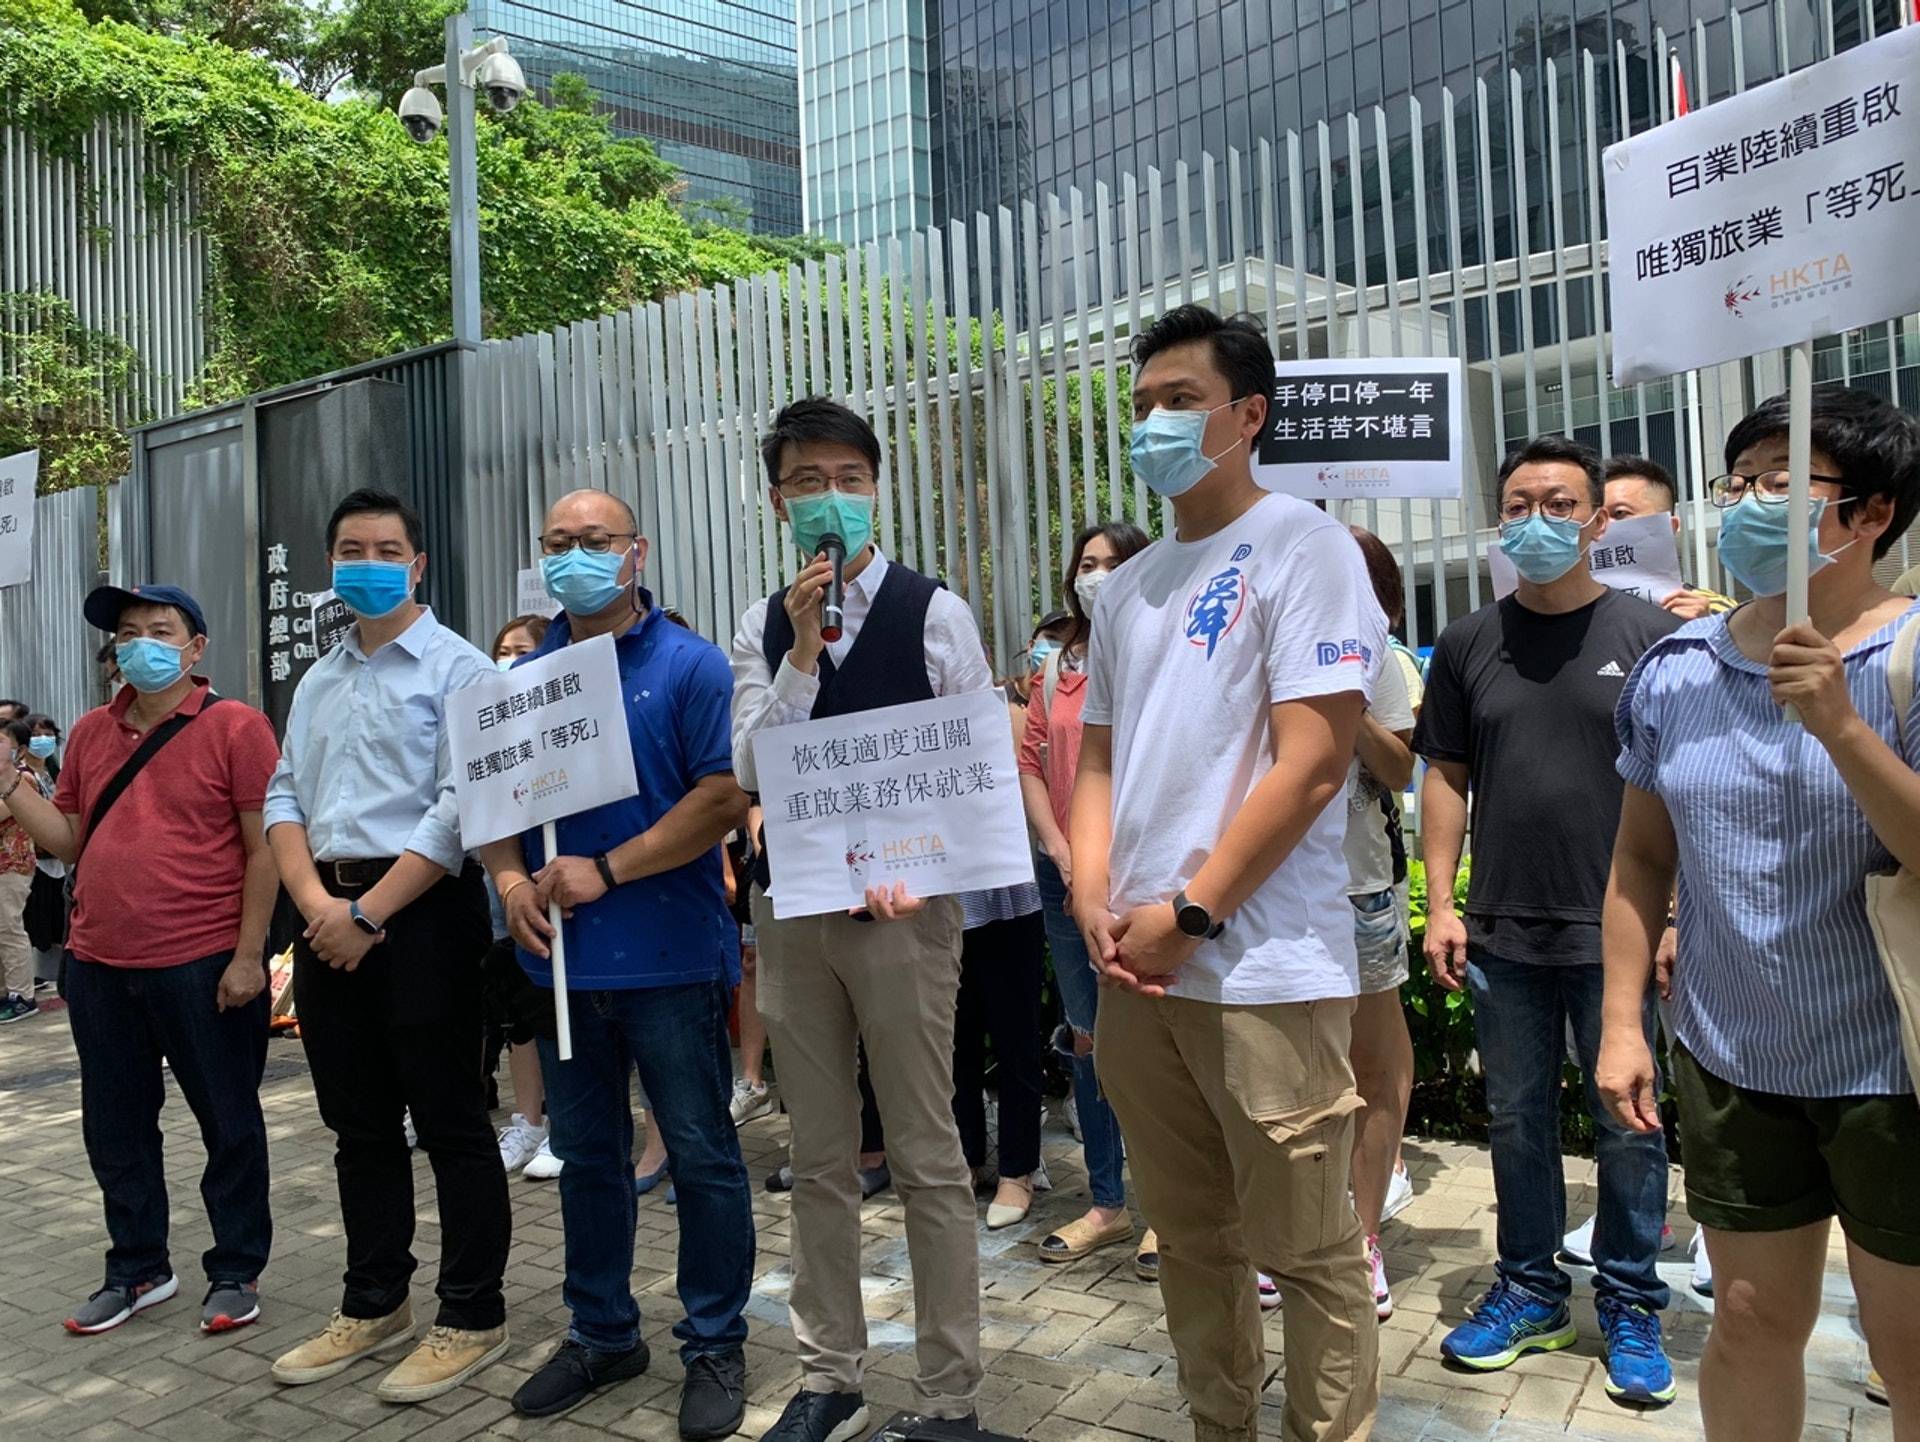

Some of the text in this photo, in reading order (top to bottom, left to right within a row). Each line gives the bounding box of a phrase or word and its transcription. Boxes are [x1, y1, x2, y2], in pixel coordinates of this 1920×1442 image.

[1666, 82, 1901, 199] 百業陸續重啟
[1769, 253, 1851, 293] HKTA
[1274, 380, 1434, 407] 手停口停一年
[1274, 414, 1434, 441] 生活苦不堪言
[1344, 467, 1389, 481] HKTA
[1589, 545, 1637, 572] 重啟
[267, 543, 292, 682] 政府總部
[477, 672, 582, 731] 百業陸續重啟
[467, 718, 599, 782] 唯獨旅業「等死」
[792, 717, 972, 775] 恢復適度通關
[531, 769, 568, 791] HKTA
[784, 762, 995, 823] 重啟業務保就業
[882, 834, 945, 859] HKTA
